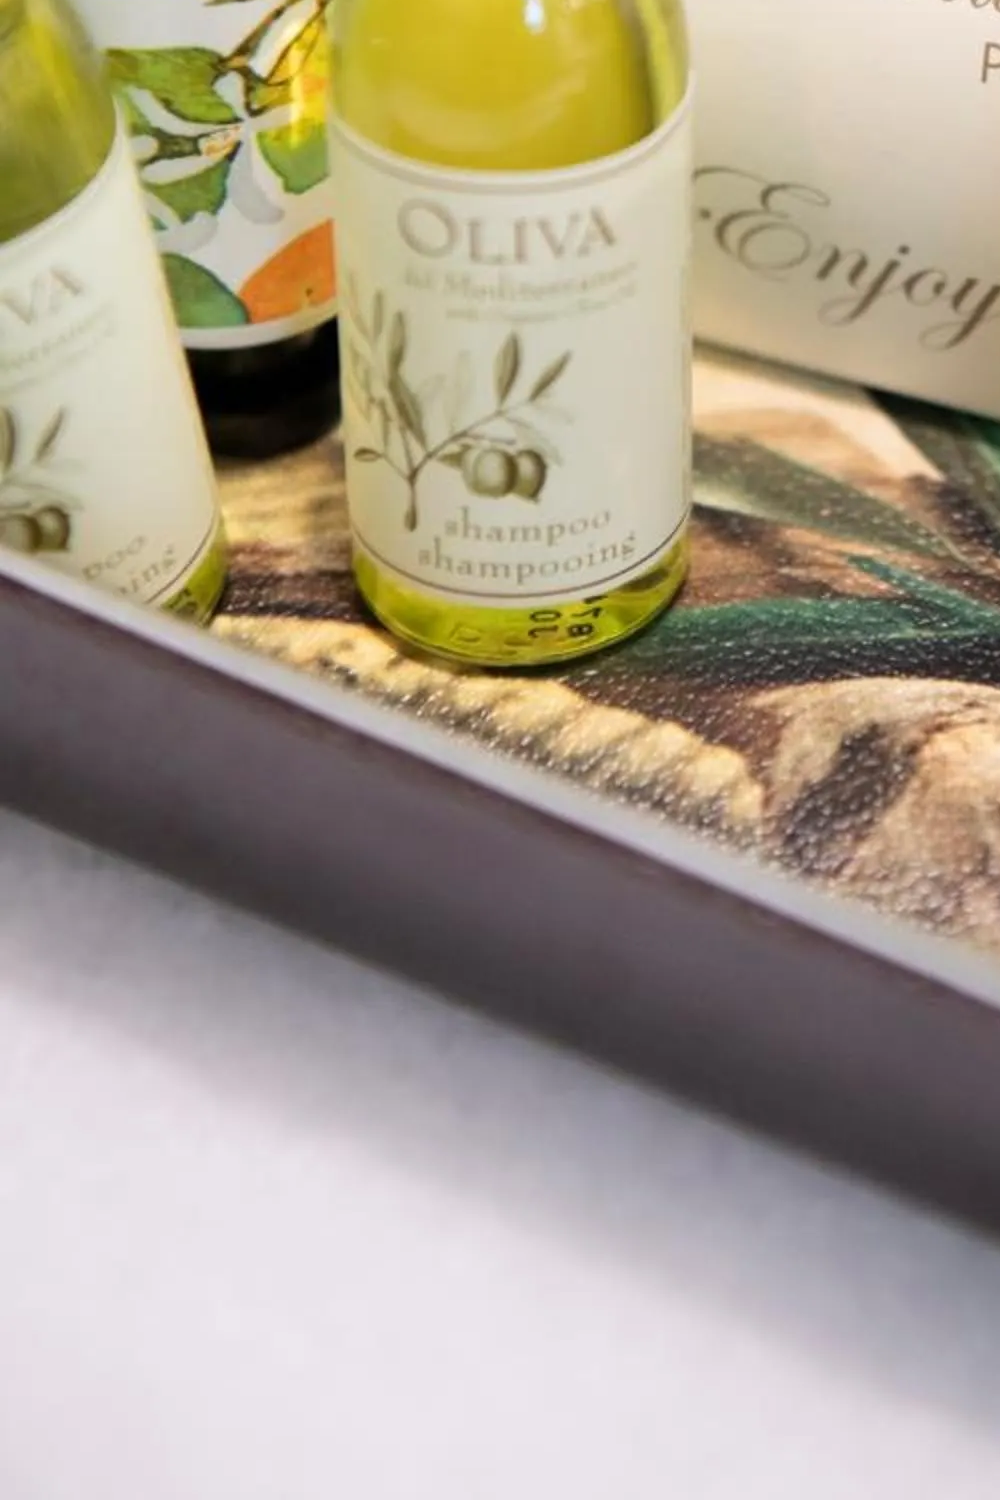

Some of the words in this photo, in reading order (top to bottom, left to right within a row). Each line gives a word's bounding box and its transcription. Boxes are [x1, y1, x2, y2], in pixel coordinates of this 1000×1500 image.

[396, 198, 618, 266] OLIVA
[444, 504, 612, 547] shampoo
[418, 529, 637, 586] shampooing
